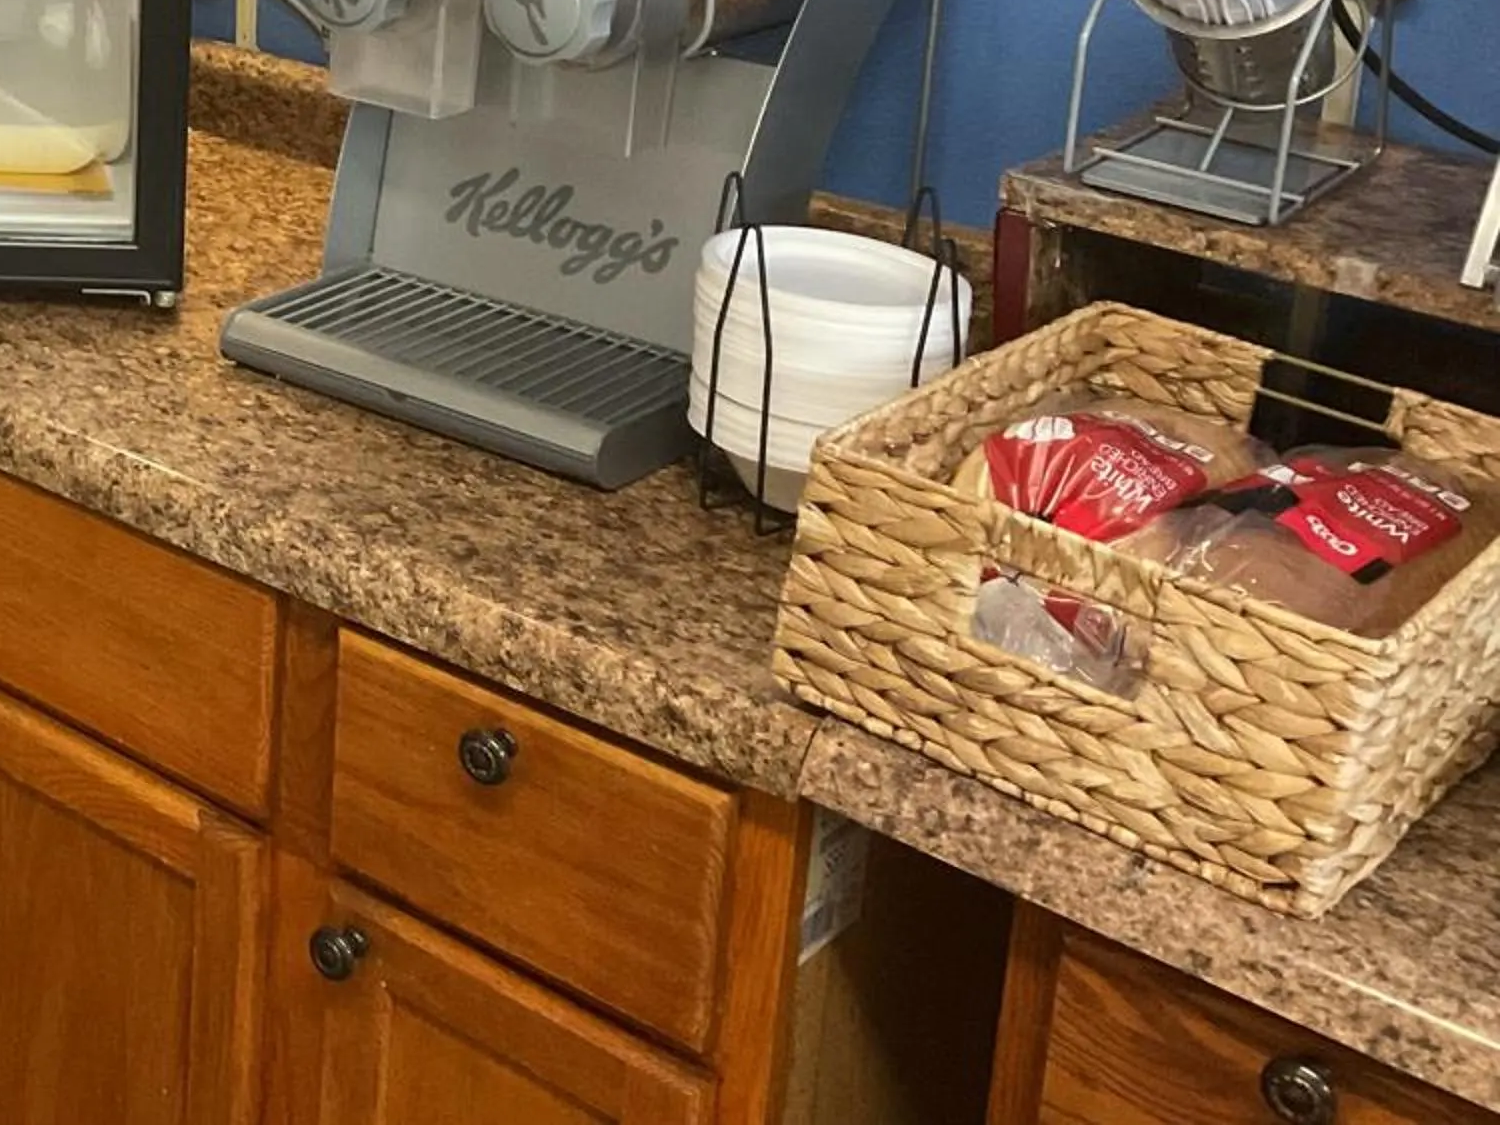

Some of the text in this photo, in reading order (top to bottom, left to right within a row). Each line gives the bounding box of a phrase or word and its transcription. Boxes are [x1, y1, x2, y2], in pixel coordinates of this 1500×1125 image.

[445, 167, 680, 284] Kellogg's
[1090, 455, 1152, 515] White
[1336, 489, 1410, 544] White
